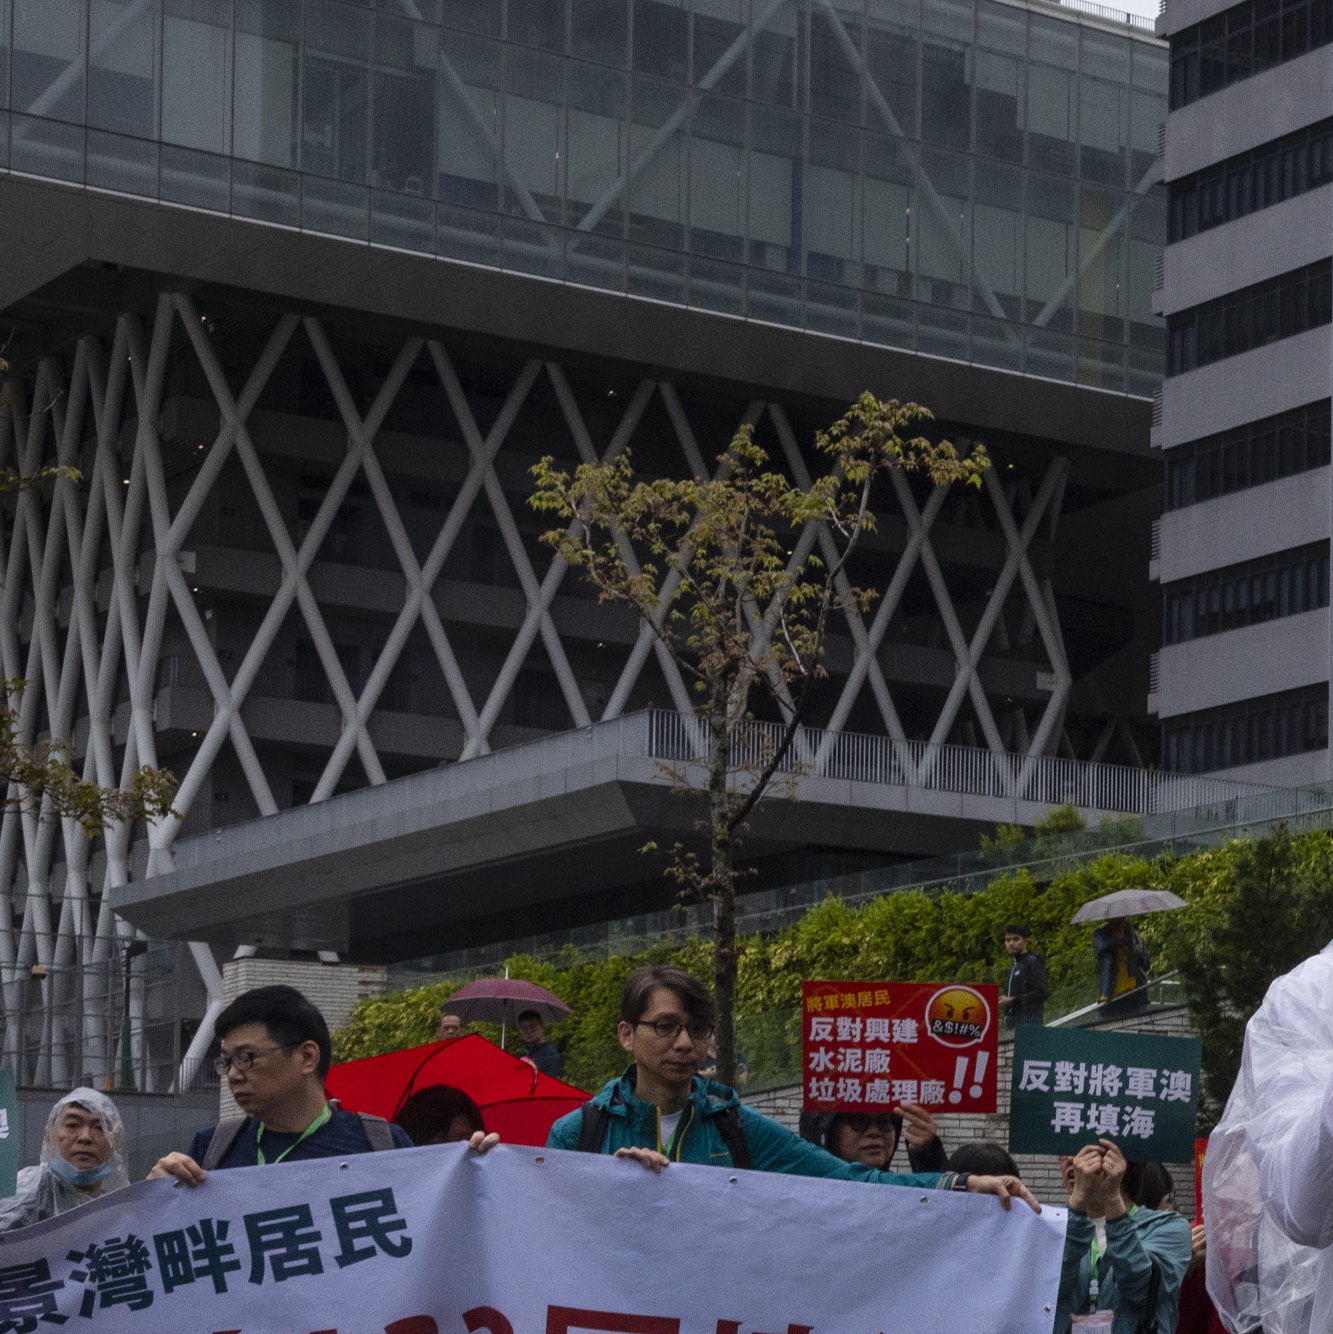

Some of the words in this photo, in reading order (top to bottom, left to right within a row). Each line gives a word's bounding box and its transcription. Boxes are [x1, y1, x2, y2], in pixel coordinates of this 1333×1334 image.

[809, 1016, 919, 1044] 反對興建
[809, 1047, 891, 1073] 水泥廠
[1018, 1059, 1192, 1103] 反對將軍澳
[1051, 1101, 1155, 1139] 再填海
